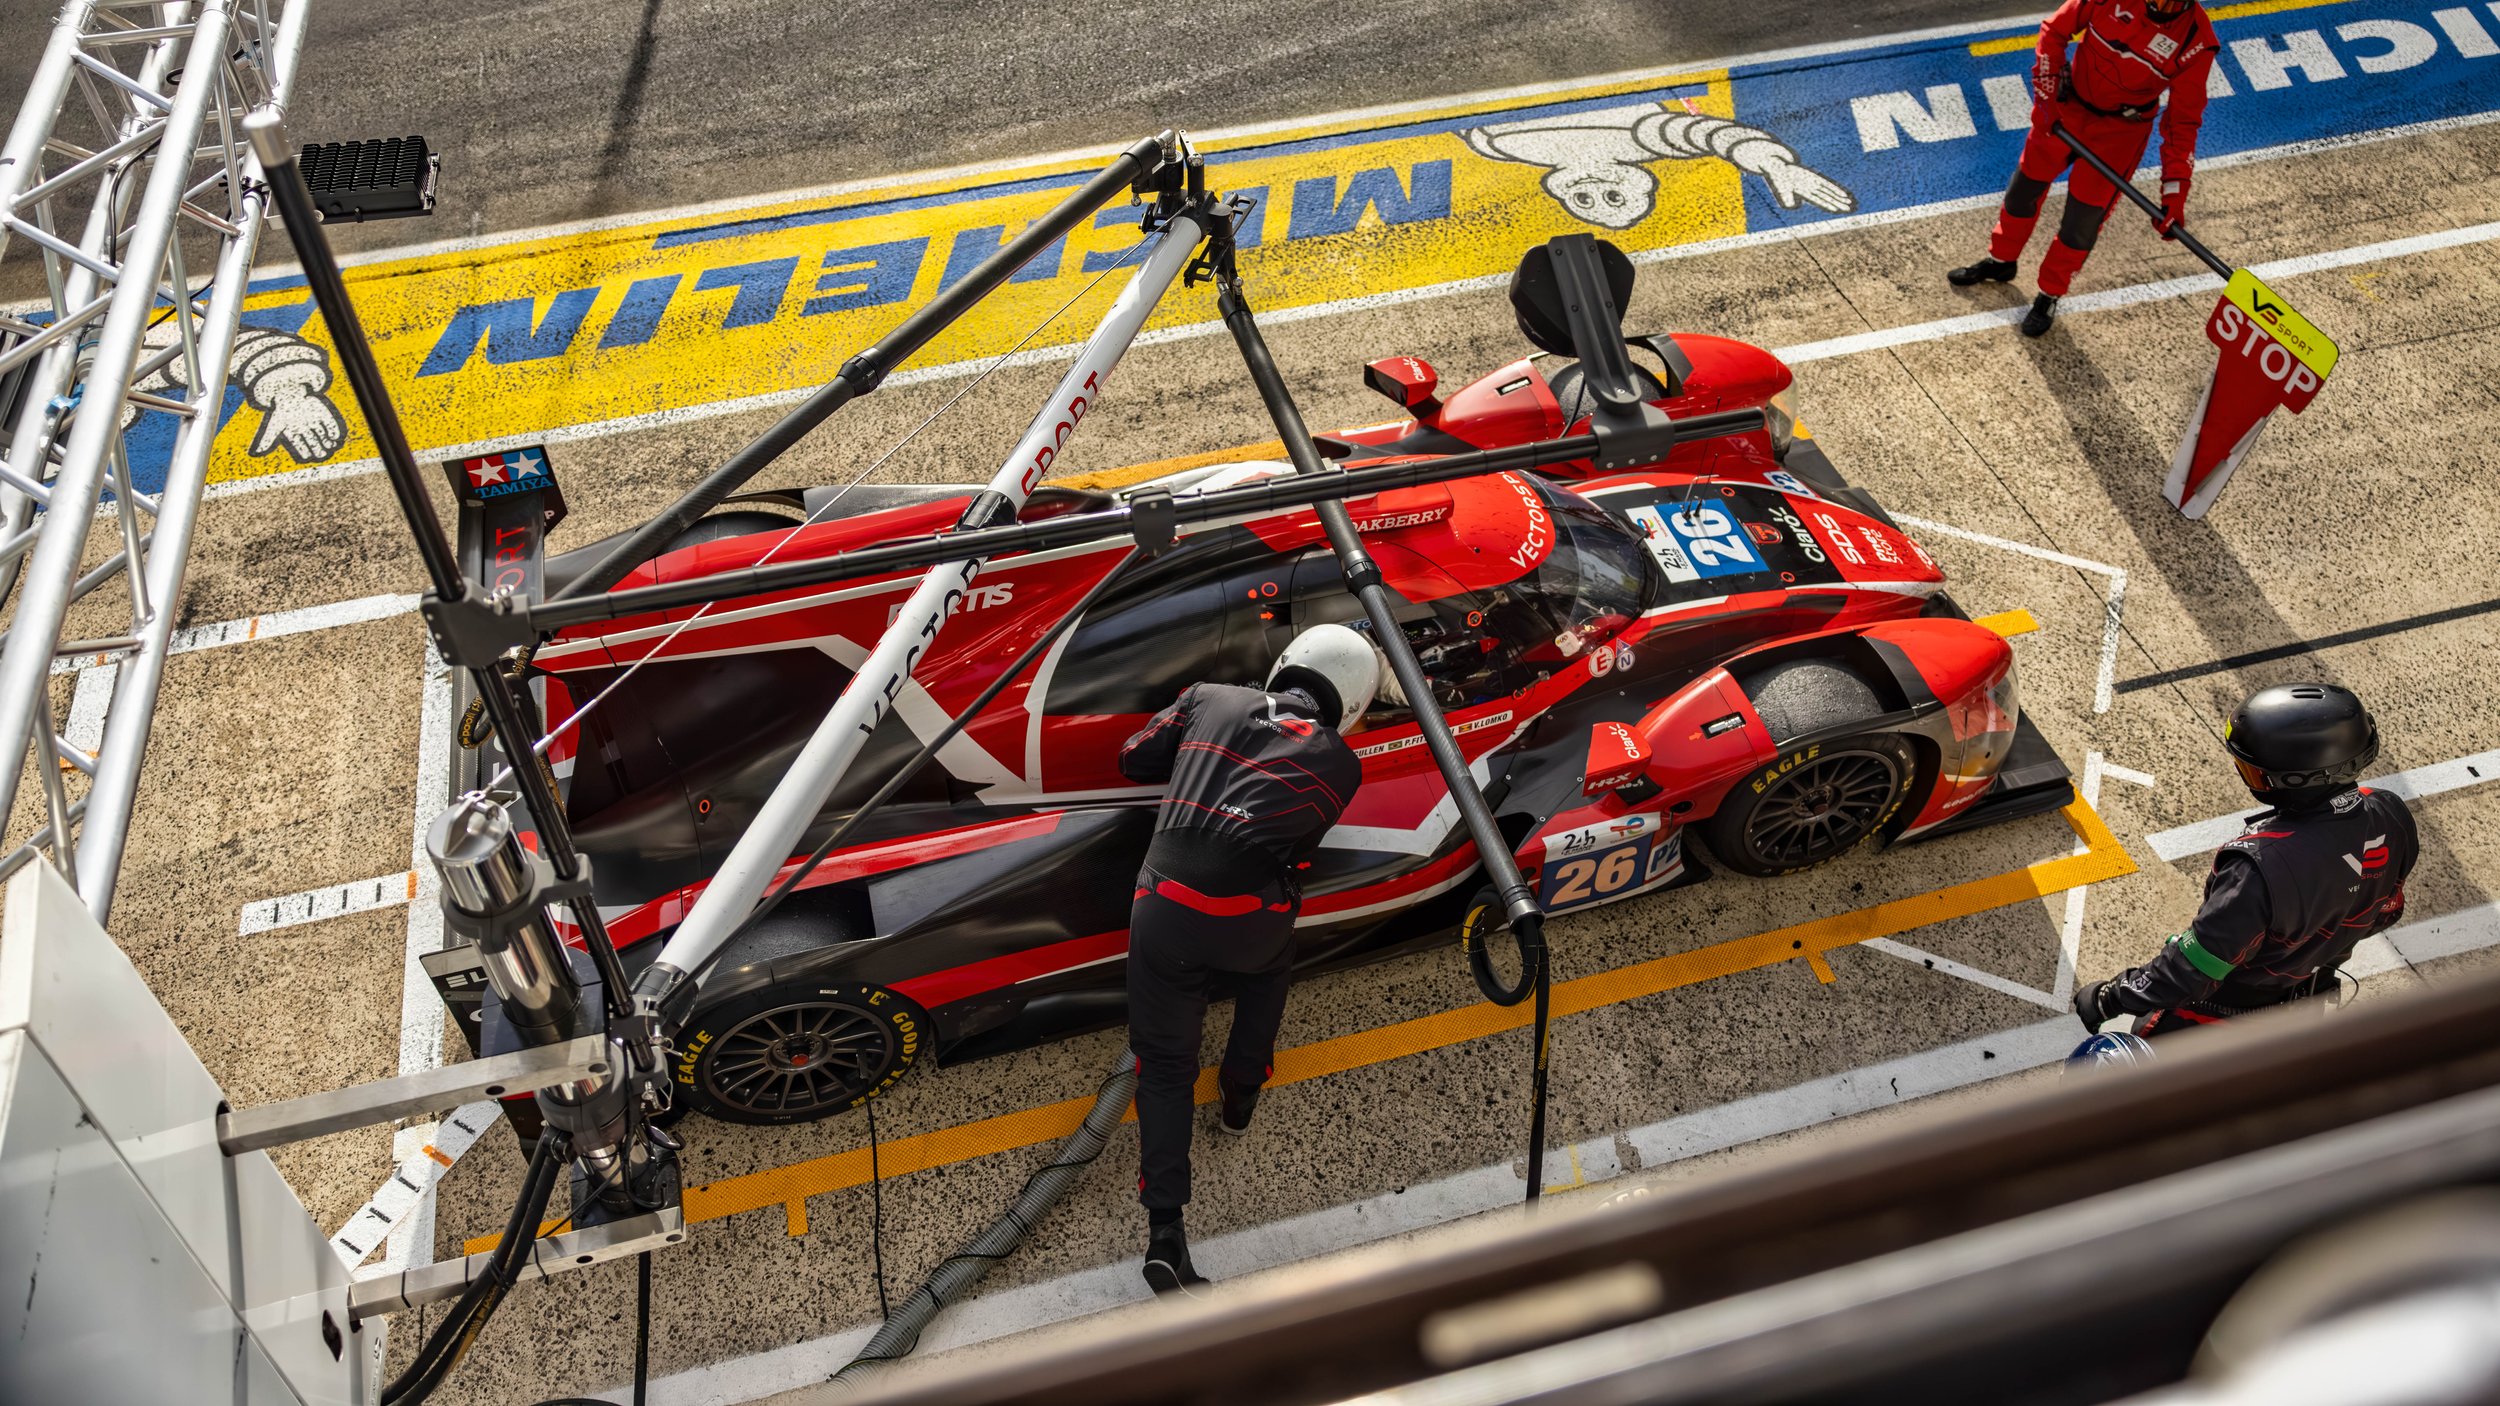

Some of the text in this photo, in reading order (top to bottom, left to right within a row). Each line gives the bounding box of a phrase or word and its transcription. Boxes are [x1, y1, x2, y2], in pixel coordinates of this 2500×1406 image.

[1850, 2, 2500, 153] ICHIN
[2215, 304, 2318, 395] STOP
[2277, 322, 2314, 356] SPORT
[474, 475, 555, 499] TAMIYA
[1499, 472, 1547, 569] VECTORSP
[1671, 508, 1756, 567] 26
[1784, 512, 1826, 563] Claro
[1813, 512, 1866, 565] SDS
[1620, 654, 1632, 668] N
[1474, 713, 1508, 728] V.LOMKO
[1616, 727, 1640, 759] Claro
[1751, 744, 1821, 794] EAGLE
[1550, 846, 1638, 906] 26
[1650, 832, 1680, 874] P2
[678, 1029, 714, 1085] EAGLE
